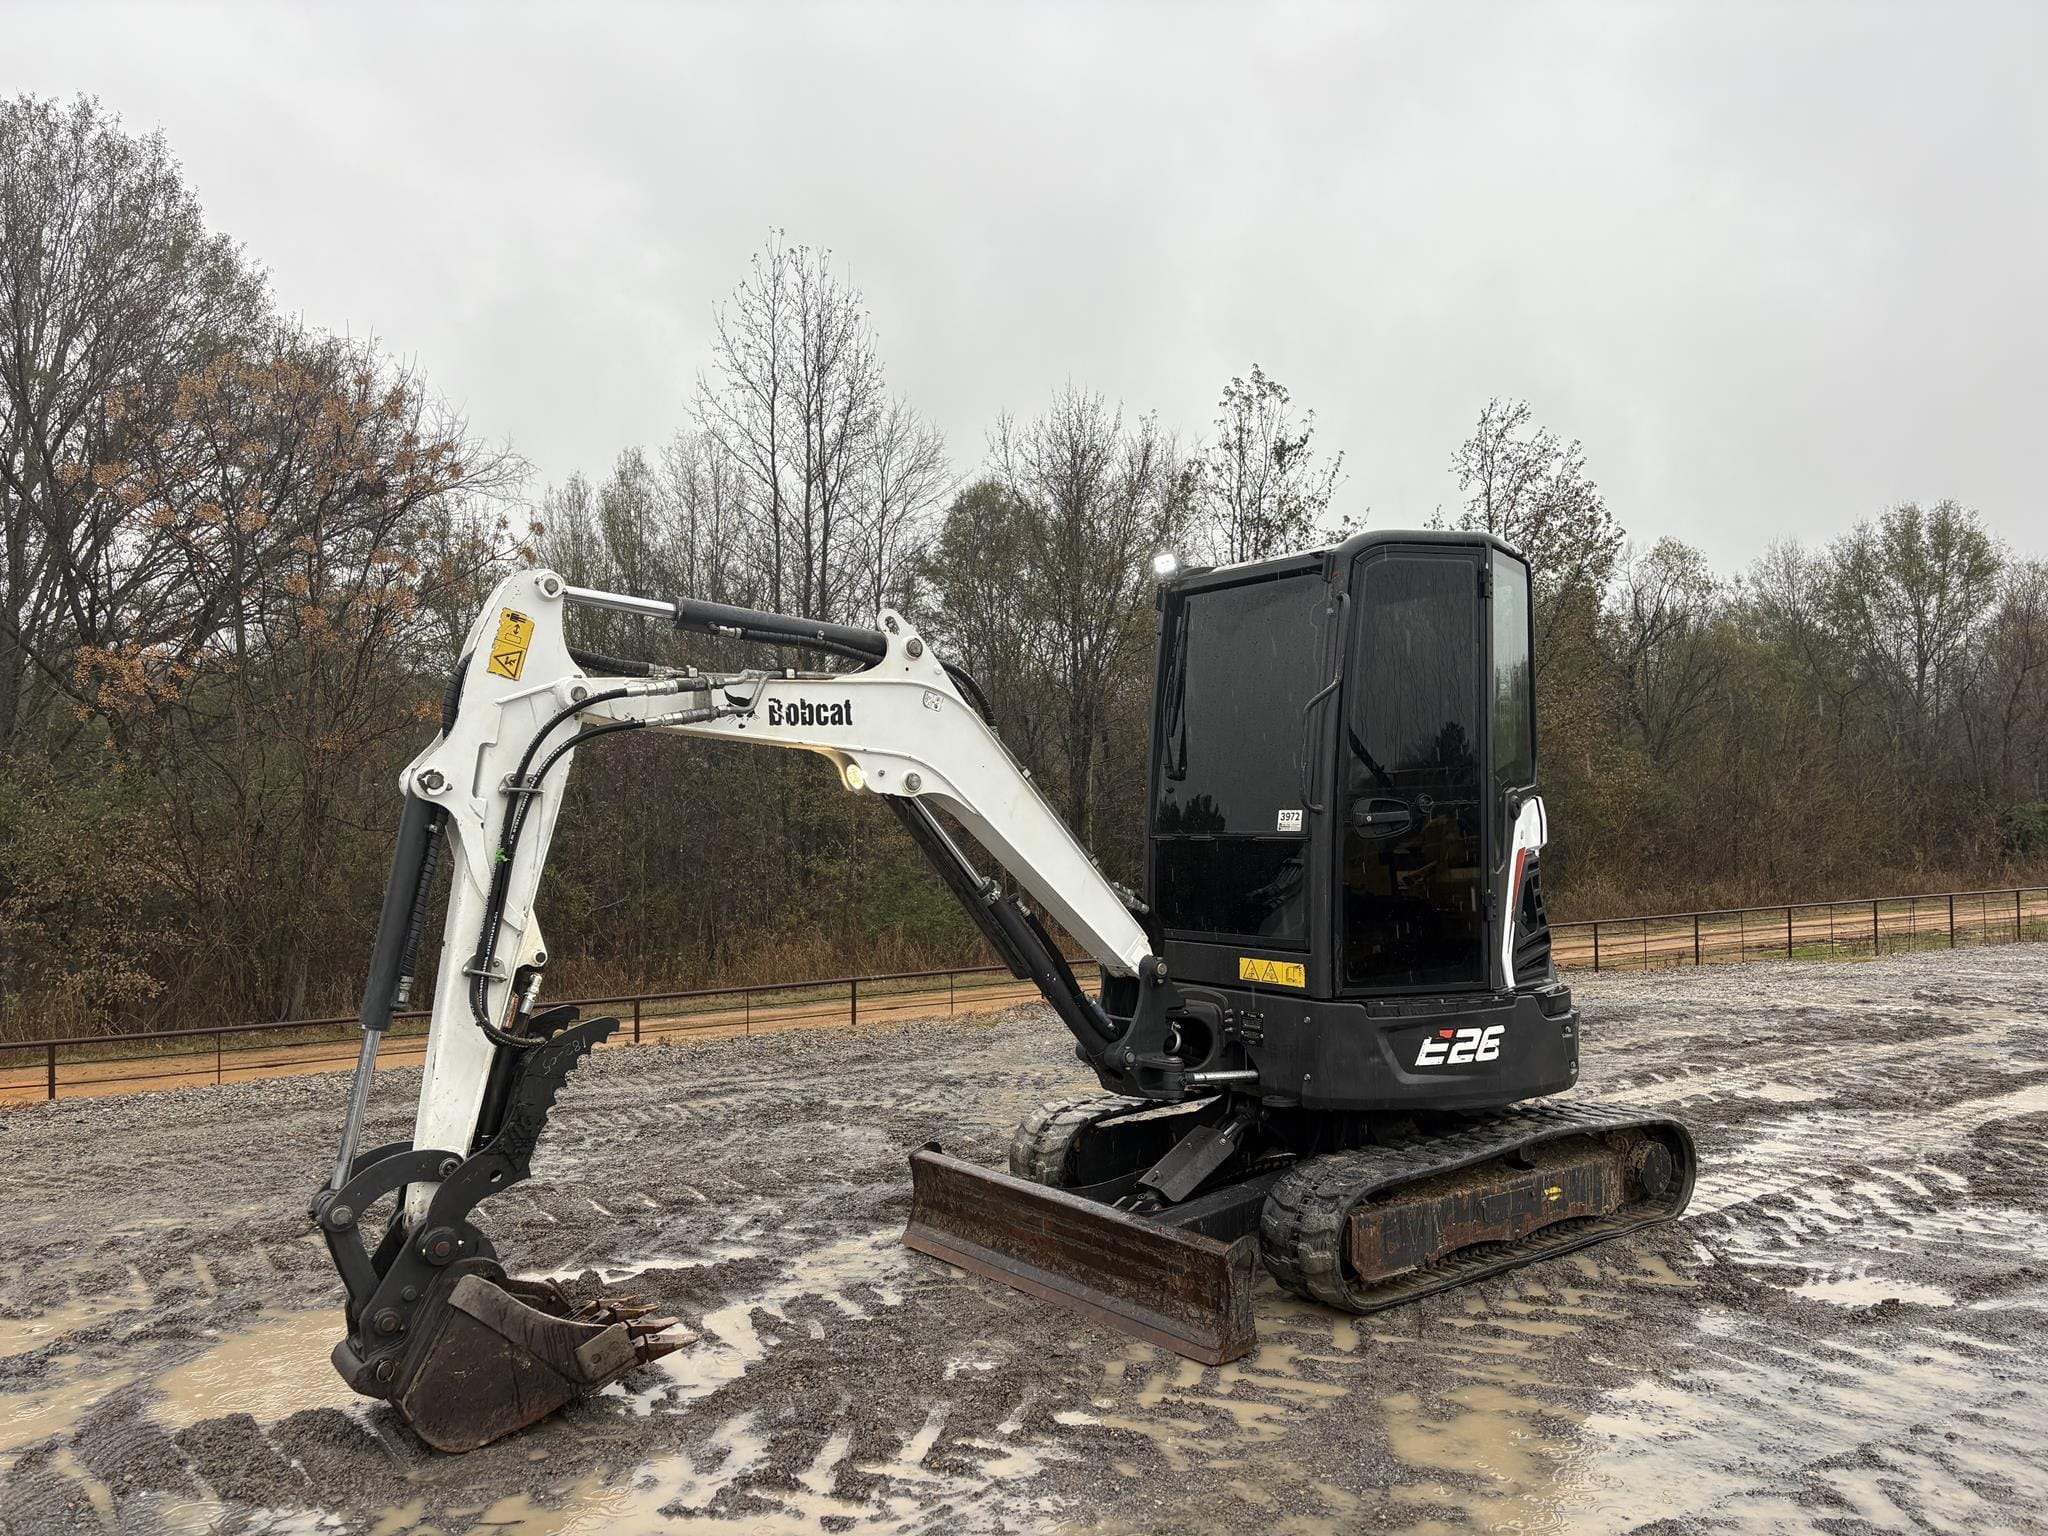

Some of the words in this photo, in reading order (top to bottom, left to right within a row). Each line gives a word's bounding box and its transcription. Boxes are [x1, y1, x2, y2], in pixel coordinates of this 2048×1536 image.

[768, 697, 853, 726] Bobcat
[1280, 812, 1301, 821] 3972
[1415, 1025, 1505, 1066] E26
